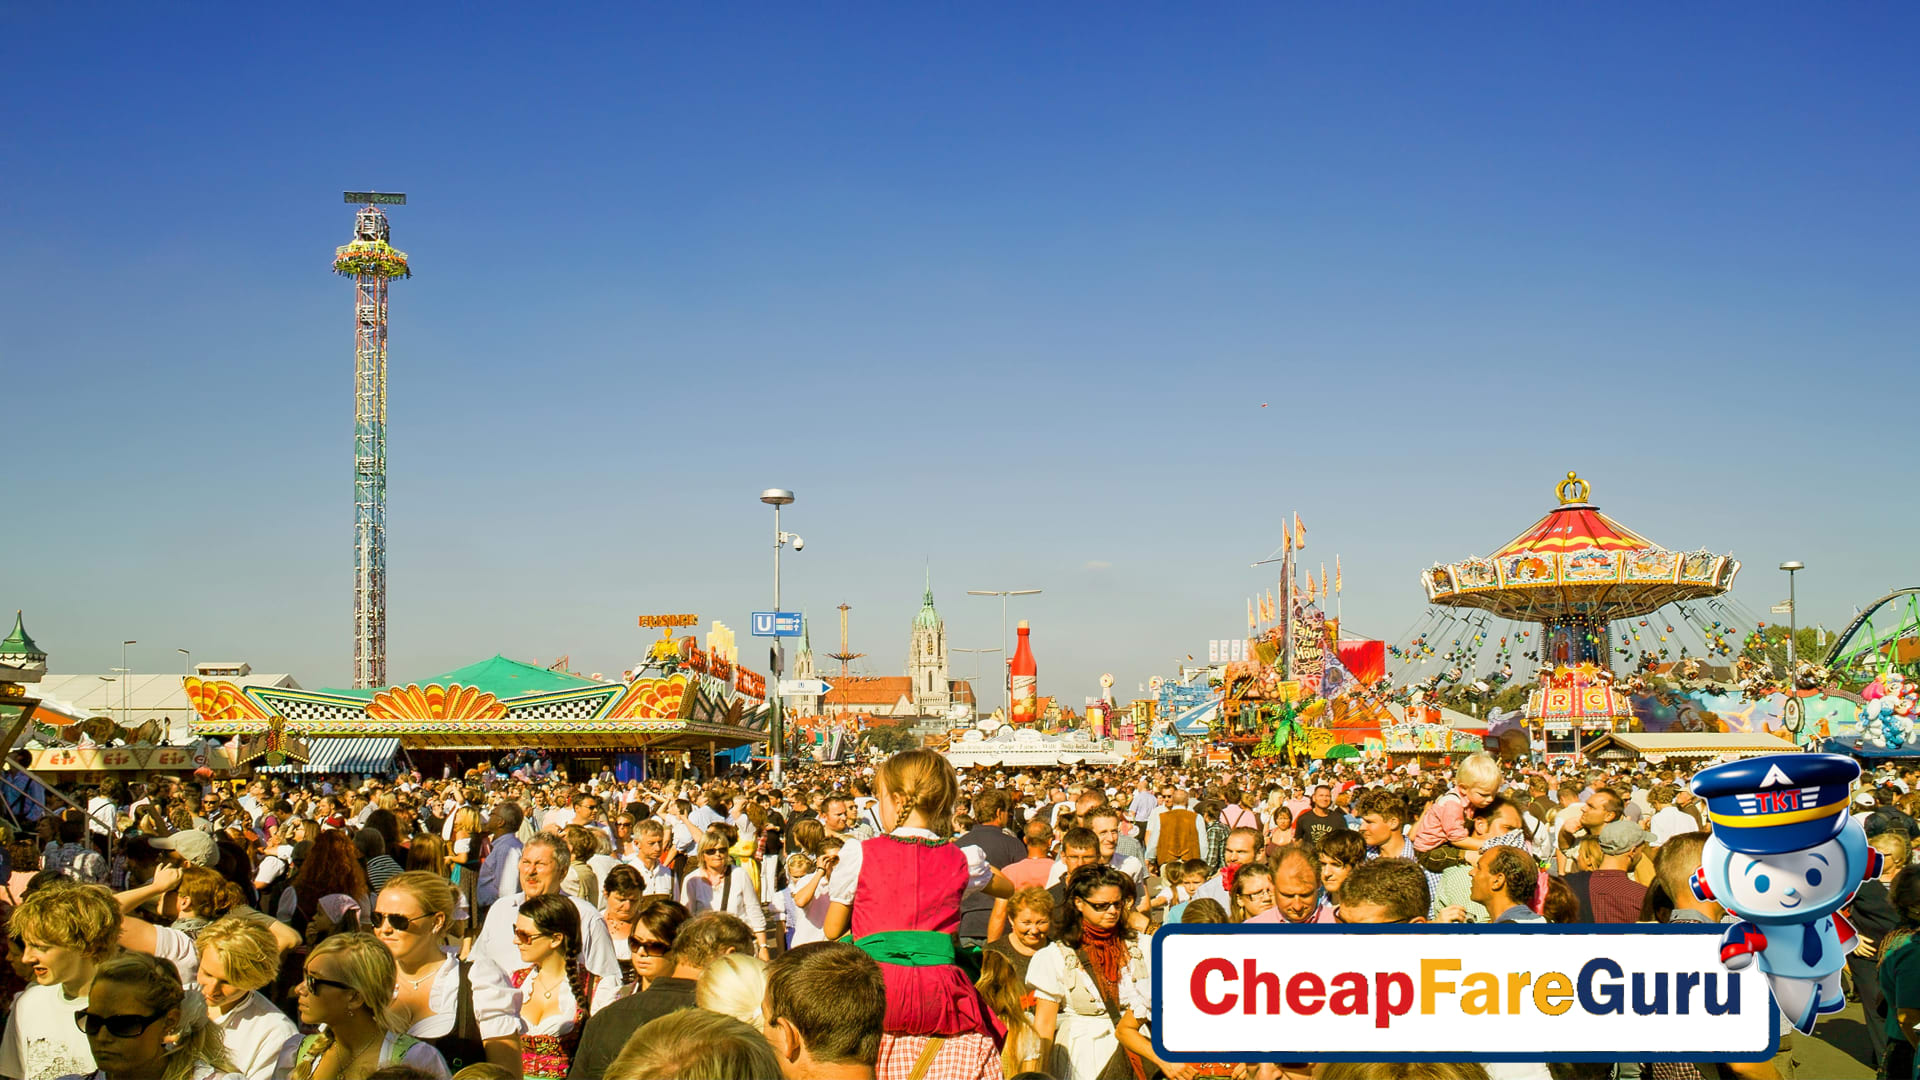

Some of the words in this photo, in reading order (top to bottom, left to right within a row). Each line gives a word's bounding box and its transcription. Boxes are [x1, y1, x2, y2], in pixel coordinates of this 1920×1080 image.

[757, 615, 771, 631] U
[1292, 620, 1324, 638] Fahrt
[1295, 646, 1323, 659] Hölle
[1552, 694, 1566, 705] R
[1589, 694, 1601, 704] C
[103, 752, 130, 765] Eis
[159, 752, 185, 765] Eis
[1311, 823, 1333, 833] POLO
